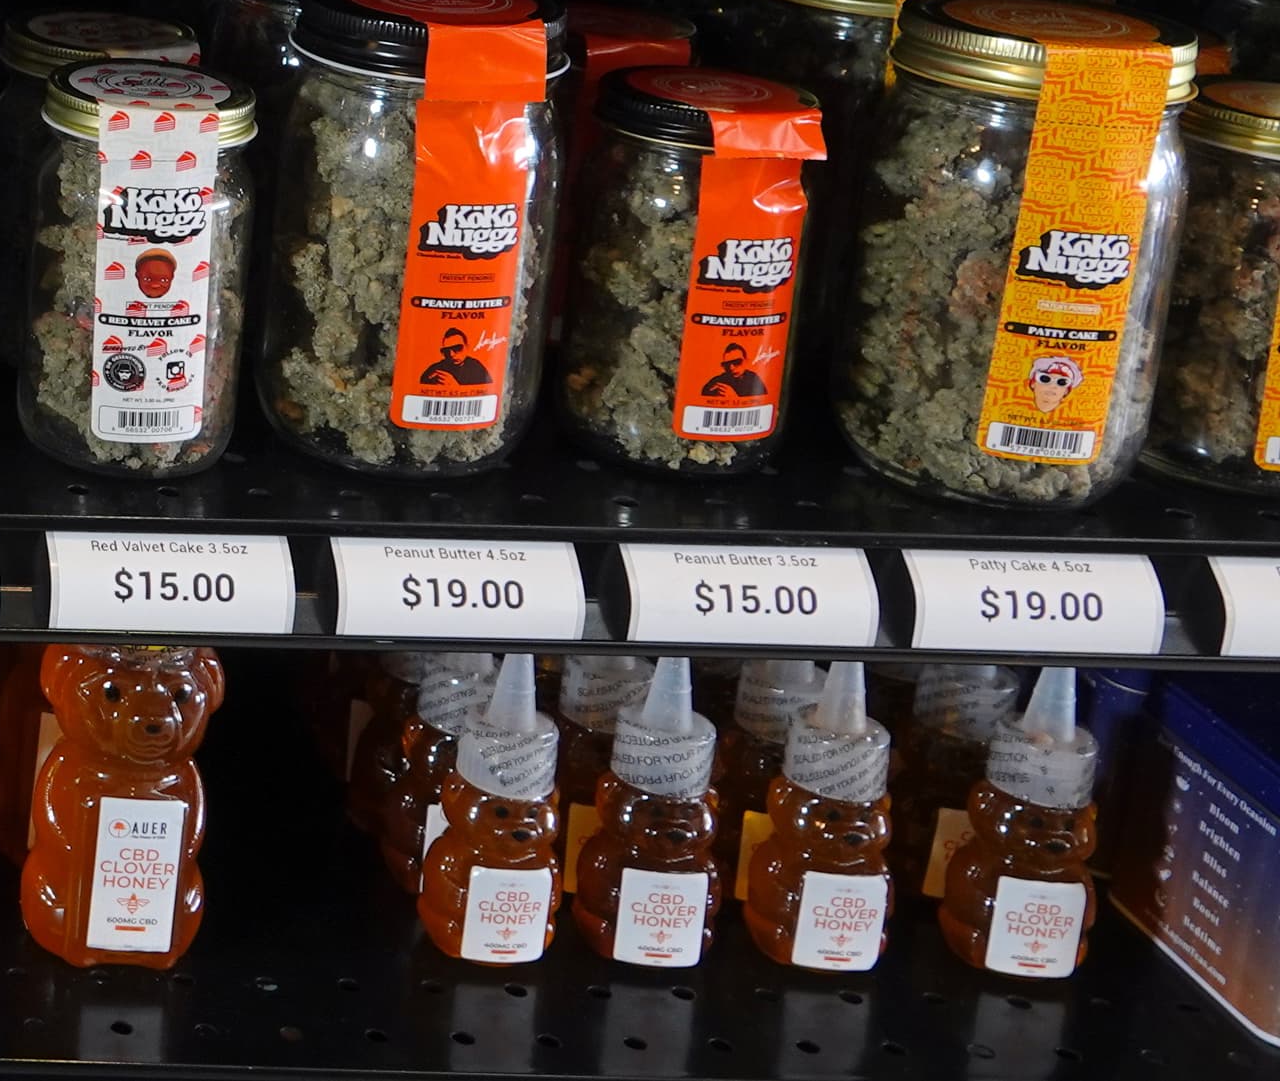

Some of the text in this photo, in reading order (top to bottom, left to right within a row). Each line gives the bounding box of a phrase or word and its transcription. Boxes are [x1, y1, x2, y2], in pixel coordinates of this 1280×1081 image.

[1028, 326, 1098, 340] PATTY CAKE
[90, 540, 248, 555] Red Valvet Cake 3.5oz
[384, 546, 527, 562] Peanut Butter 4.5oz
[674, 552, 818, 568] Peanut Butter 3.5oz
[969, 558, 1092, 573] Patty Cake 4.5oz
[113, 567, 236, 604] $15.00
[401, 573, 525, 610] $19.00
[694, 579, 818, 616] $15.00
[980, 585, 1103, 622] $19.00
[1209, 803, 1240, 835] Bloom
[1199, 821, 1241, 862] Brighten
[495, 891, 530, 903] CBD
[478, 900, 543, 913] CLOVER
[480, 913, 537, 925] HONEY
